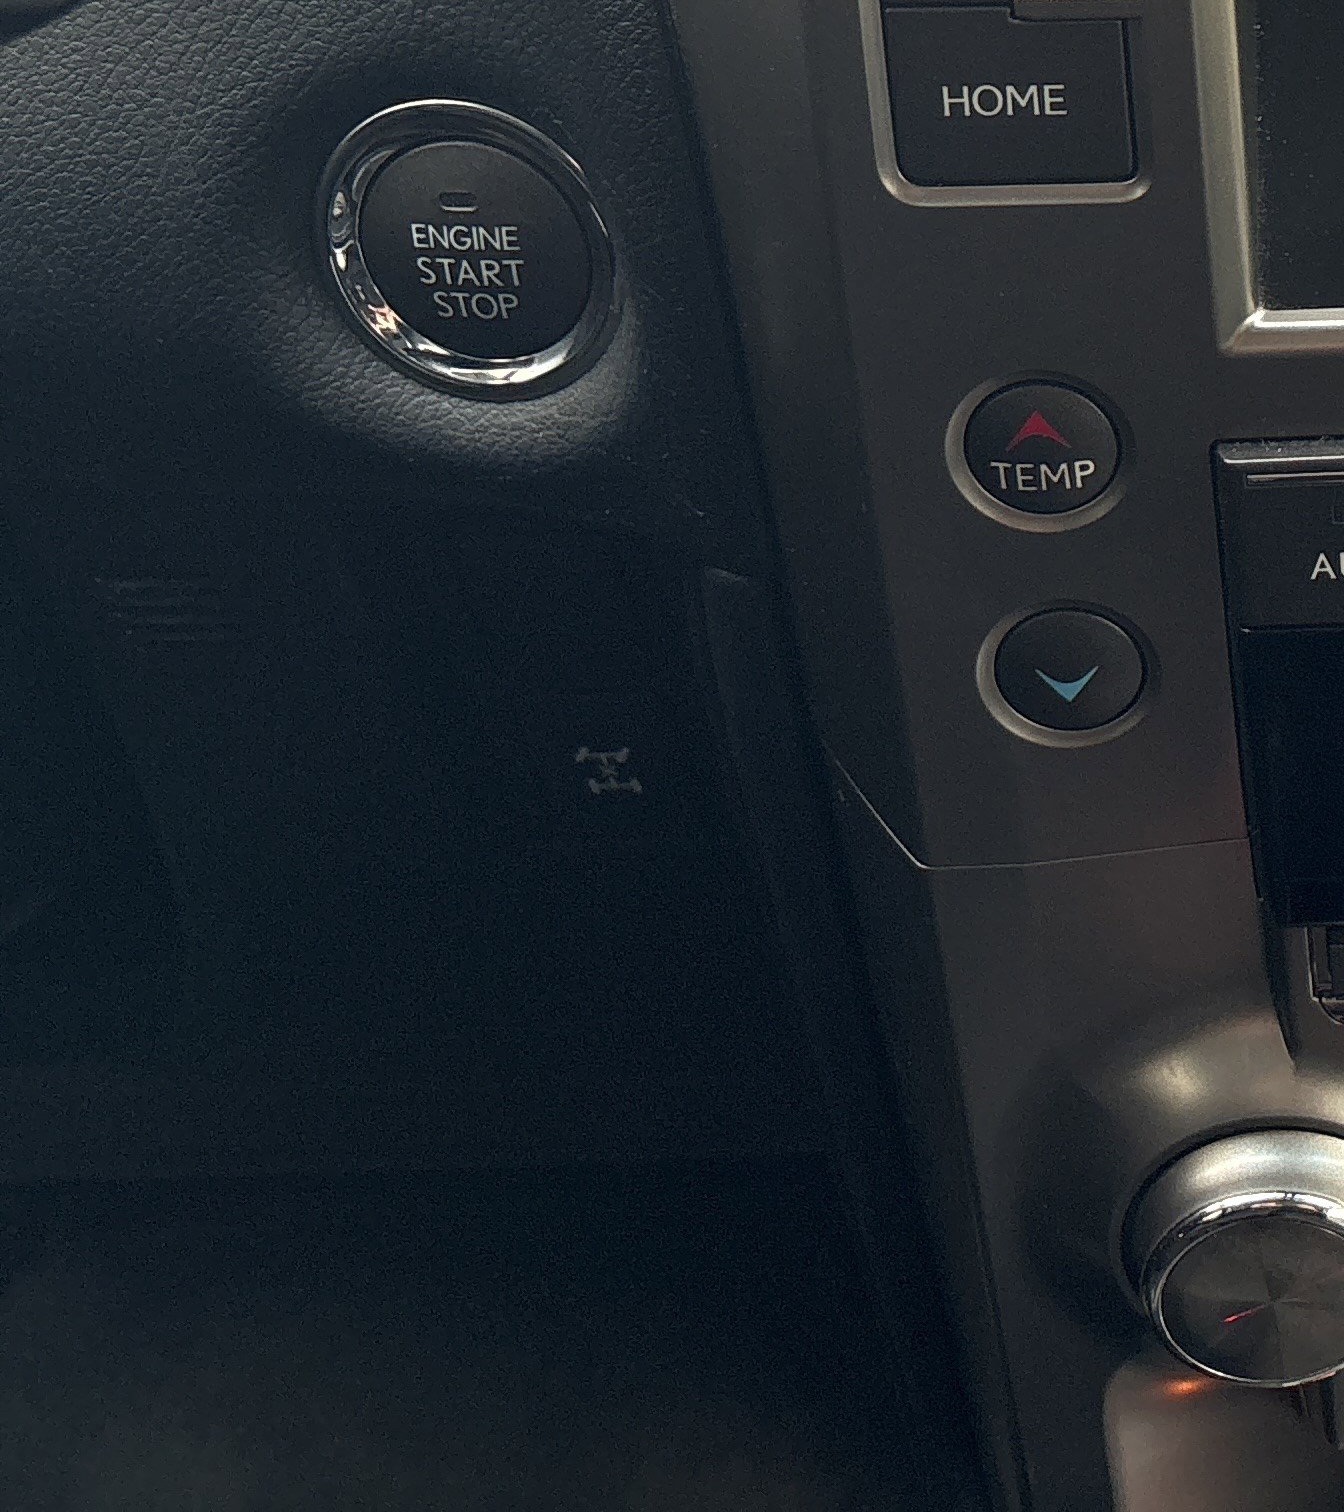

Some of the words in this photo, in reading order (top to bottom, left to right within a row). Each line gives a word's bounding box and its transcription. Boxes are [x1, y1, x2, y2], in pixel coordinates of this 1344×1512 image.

[941, 84, 1068, 118] HOME
[410, 223, 522, 252] ENGINE
[415, 257, 525, 287] START
[432, 291, 520, 320] STOP
[989, 458, 1096, 492] TEMP
